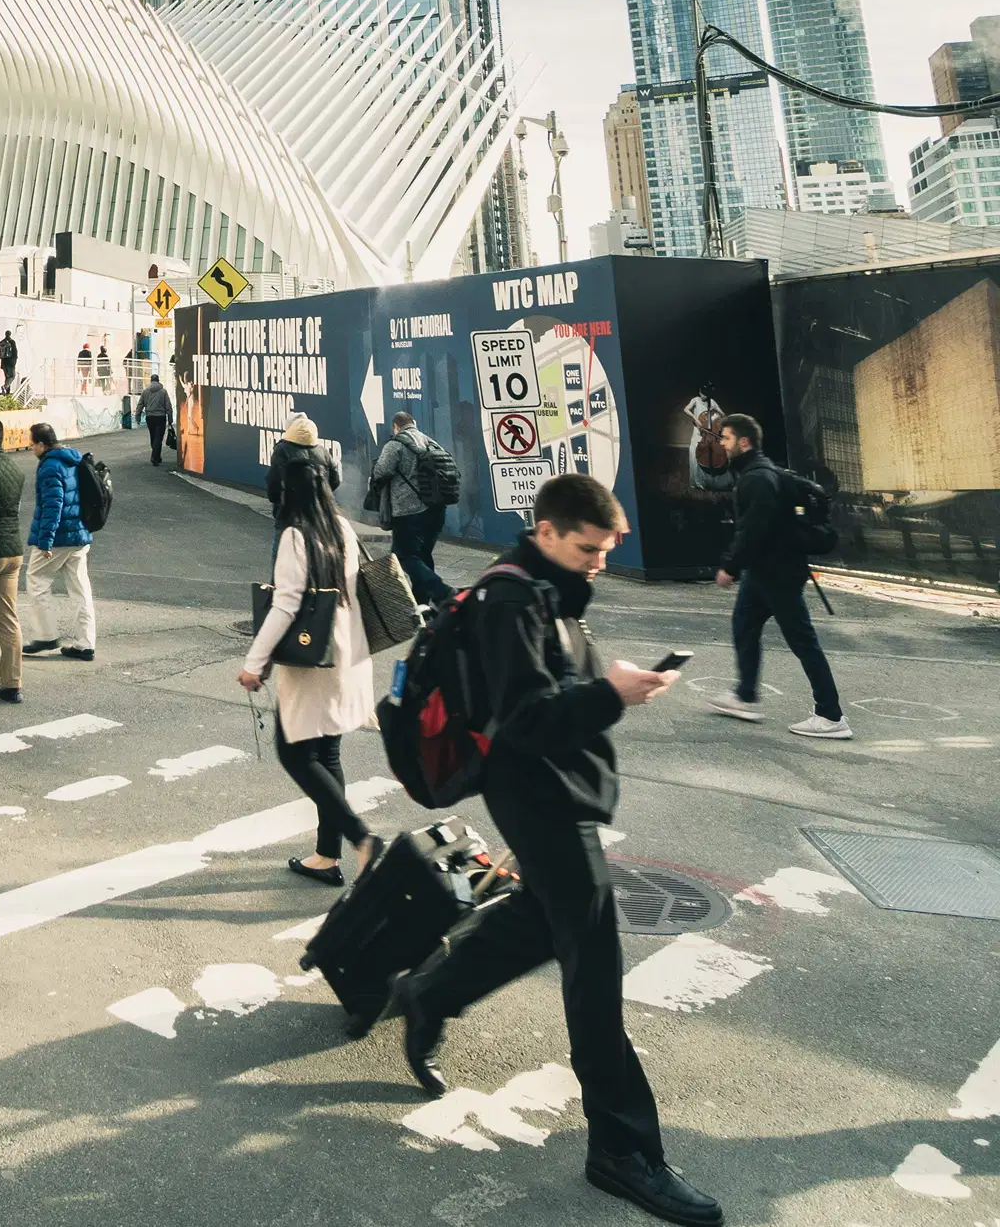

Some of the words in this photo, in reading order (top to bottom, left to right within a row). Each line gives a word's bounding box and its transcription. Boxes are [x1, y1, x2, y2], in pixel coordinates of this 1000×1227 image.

[639, 88, 651, 97] W
[492, 277, 534, 311] WTC
[536, 271, 579, 306] MAP
[390, 318, 409, 339] 9/11
[411, 314, 454, 338] MEMORIAL
[553, 323, 570, 338] YOU
[572, 322, 588, 336] ARE
[589, 320, 612, 335] HERE
[209, 321, 226, 353] THE
[228, 319, 266, 353] FUTURE
[268, 317, 303, 354] HOME
[305, 316, 322, 354] OF
[481, 339, 525, 352] SPEED
[488, 355, 522, 367] LIMIT
[192, 354, 209, 386] THE
[210, 354, 249, 389] RONALD
[250, 355, 262, 390] O.
[263, 356, 327, 395] PERELMAN
[392, 367, 421, 390] OCULUS
[489, 372, 528, 401] 10
[570, 408, 583, 416] PAC
[501, 467, 543, 477] BEYOND
[512, 481, 536, 490] THIS
[511, 494, 538, 505] POIN
